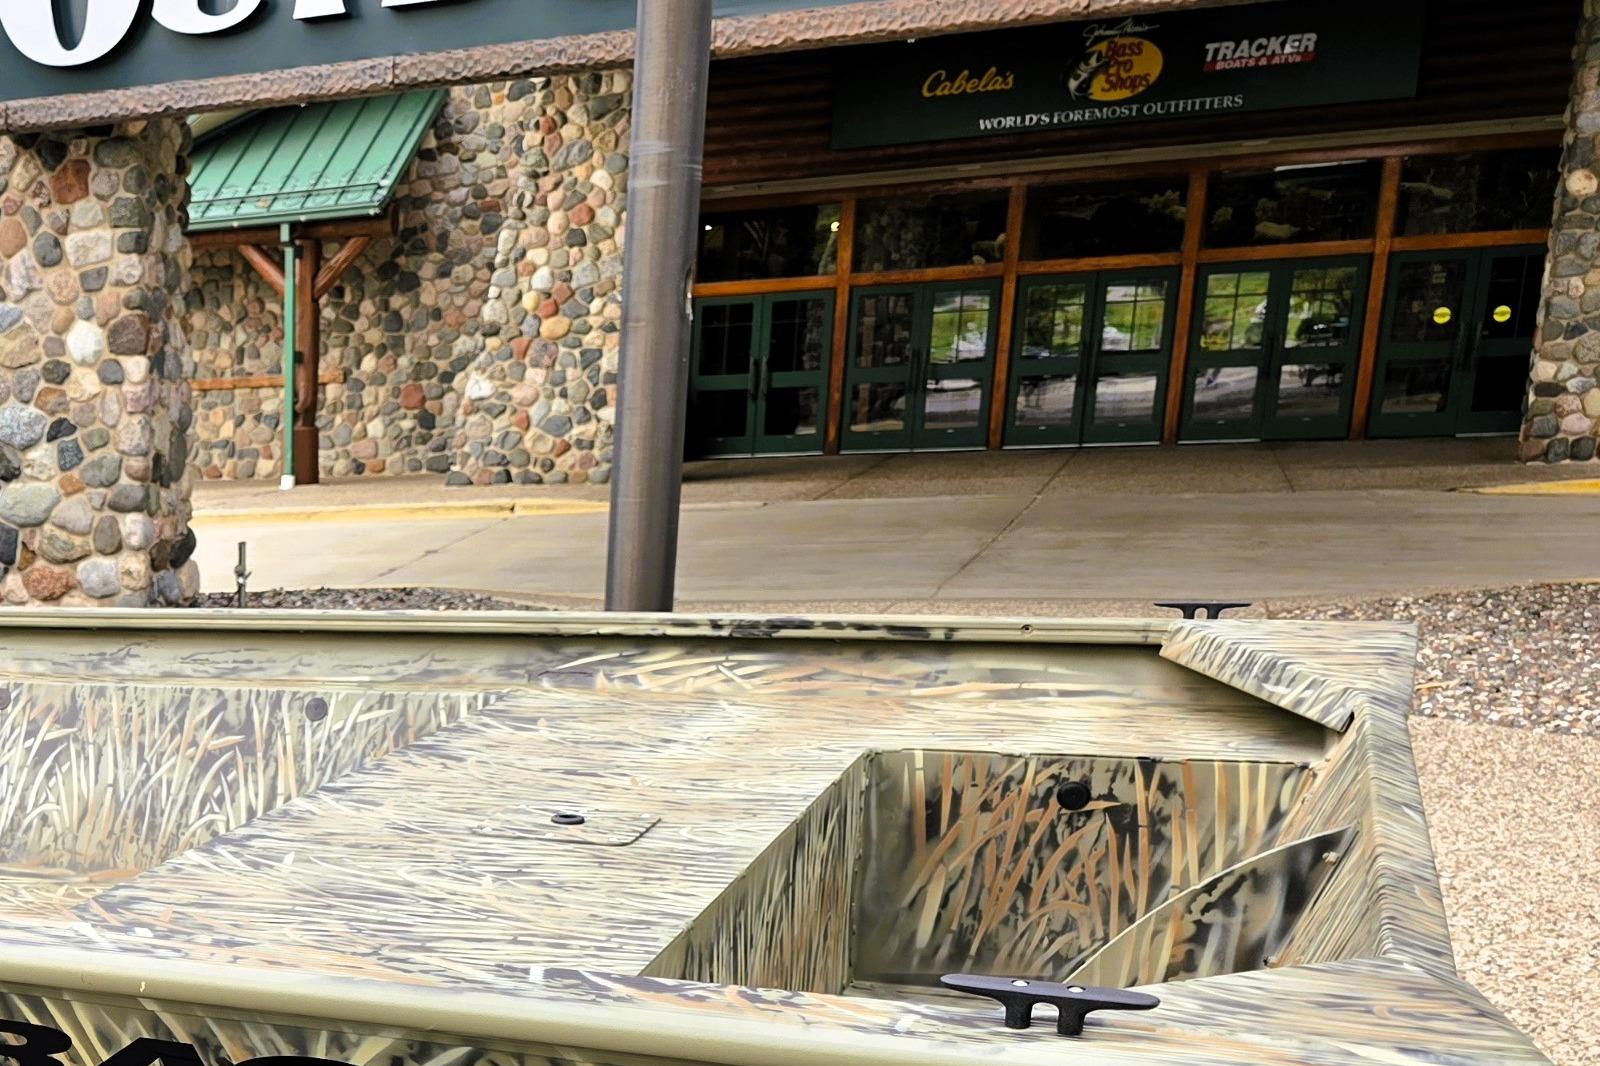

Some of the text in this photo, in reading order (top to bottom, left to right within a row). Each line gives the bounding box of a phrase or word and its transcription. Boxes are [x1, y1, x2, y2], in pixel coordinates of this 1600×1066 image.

[1106, 40, 1144, 57] Bass
[1204, 33, 1317, 62] TRACKER
[1215, 58, 1256, 71] BOATS
[1258, 56, 1267, 66] &
[922, 66, 1014, 97] Cabela's
[1101, 73, 1152, 93] Shops
[979, 94, 1243, 130] WORLD'S FOREMOST OUTFITTERS
